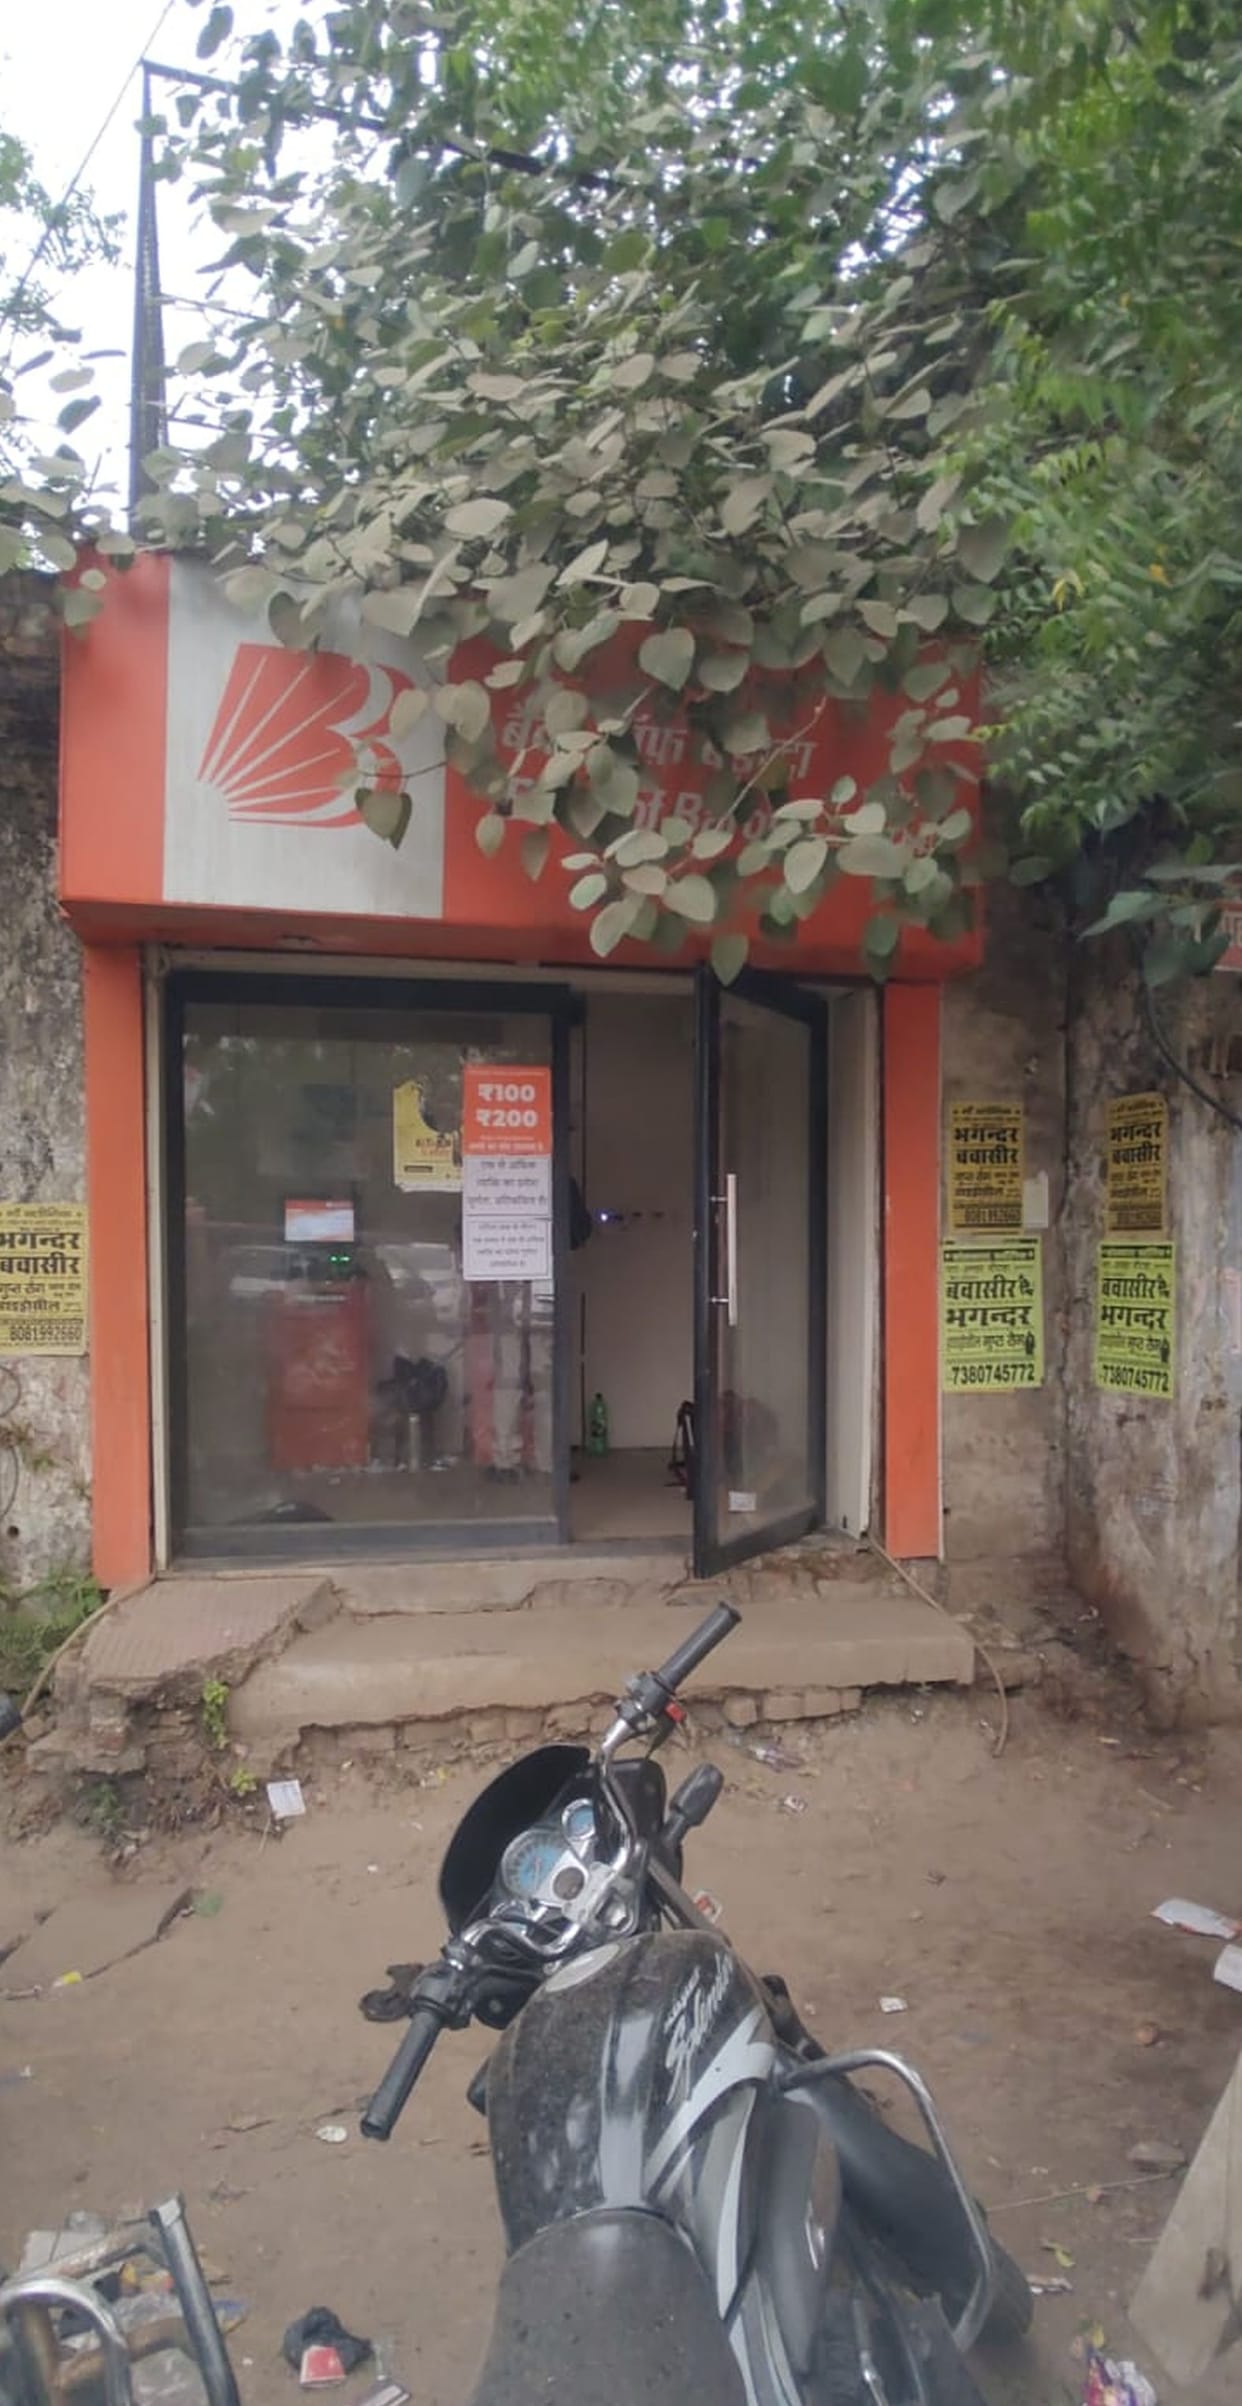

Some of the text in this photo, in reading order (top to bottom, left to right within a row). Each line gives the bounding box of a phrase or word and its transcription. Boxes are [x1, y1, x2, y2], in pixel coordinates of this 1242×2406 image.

[477, 1083, 536, 1103] ₹100
[476, 1109, 539, 1128] ₹200
[953, 1127, 1021, 1142] भगन्दर
[1110, 1121, 1163, 1142] भगन्दर
[955, 1145, 1021, 1164] बवासीर
[0, 1251, 80, 1274] बवासीर
[945, 1274, 1017, 1299] बवासीर
[1102, 1272, 1156, 1299] बवासीर
[946, 1306, 1032, 1327] भगन्दर
[1101, 1305, 1169, 1330] भगन्दर
[952, 1363, 1035, 1385] 7380745772
[1102, 1364, 1170, 1393] 7380745772
